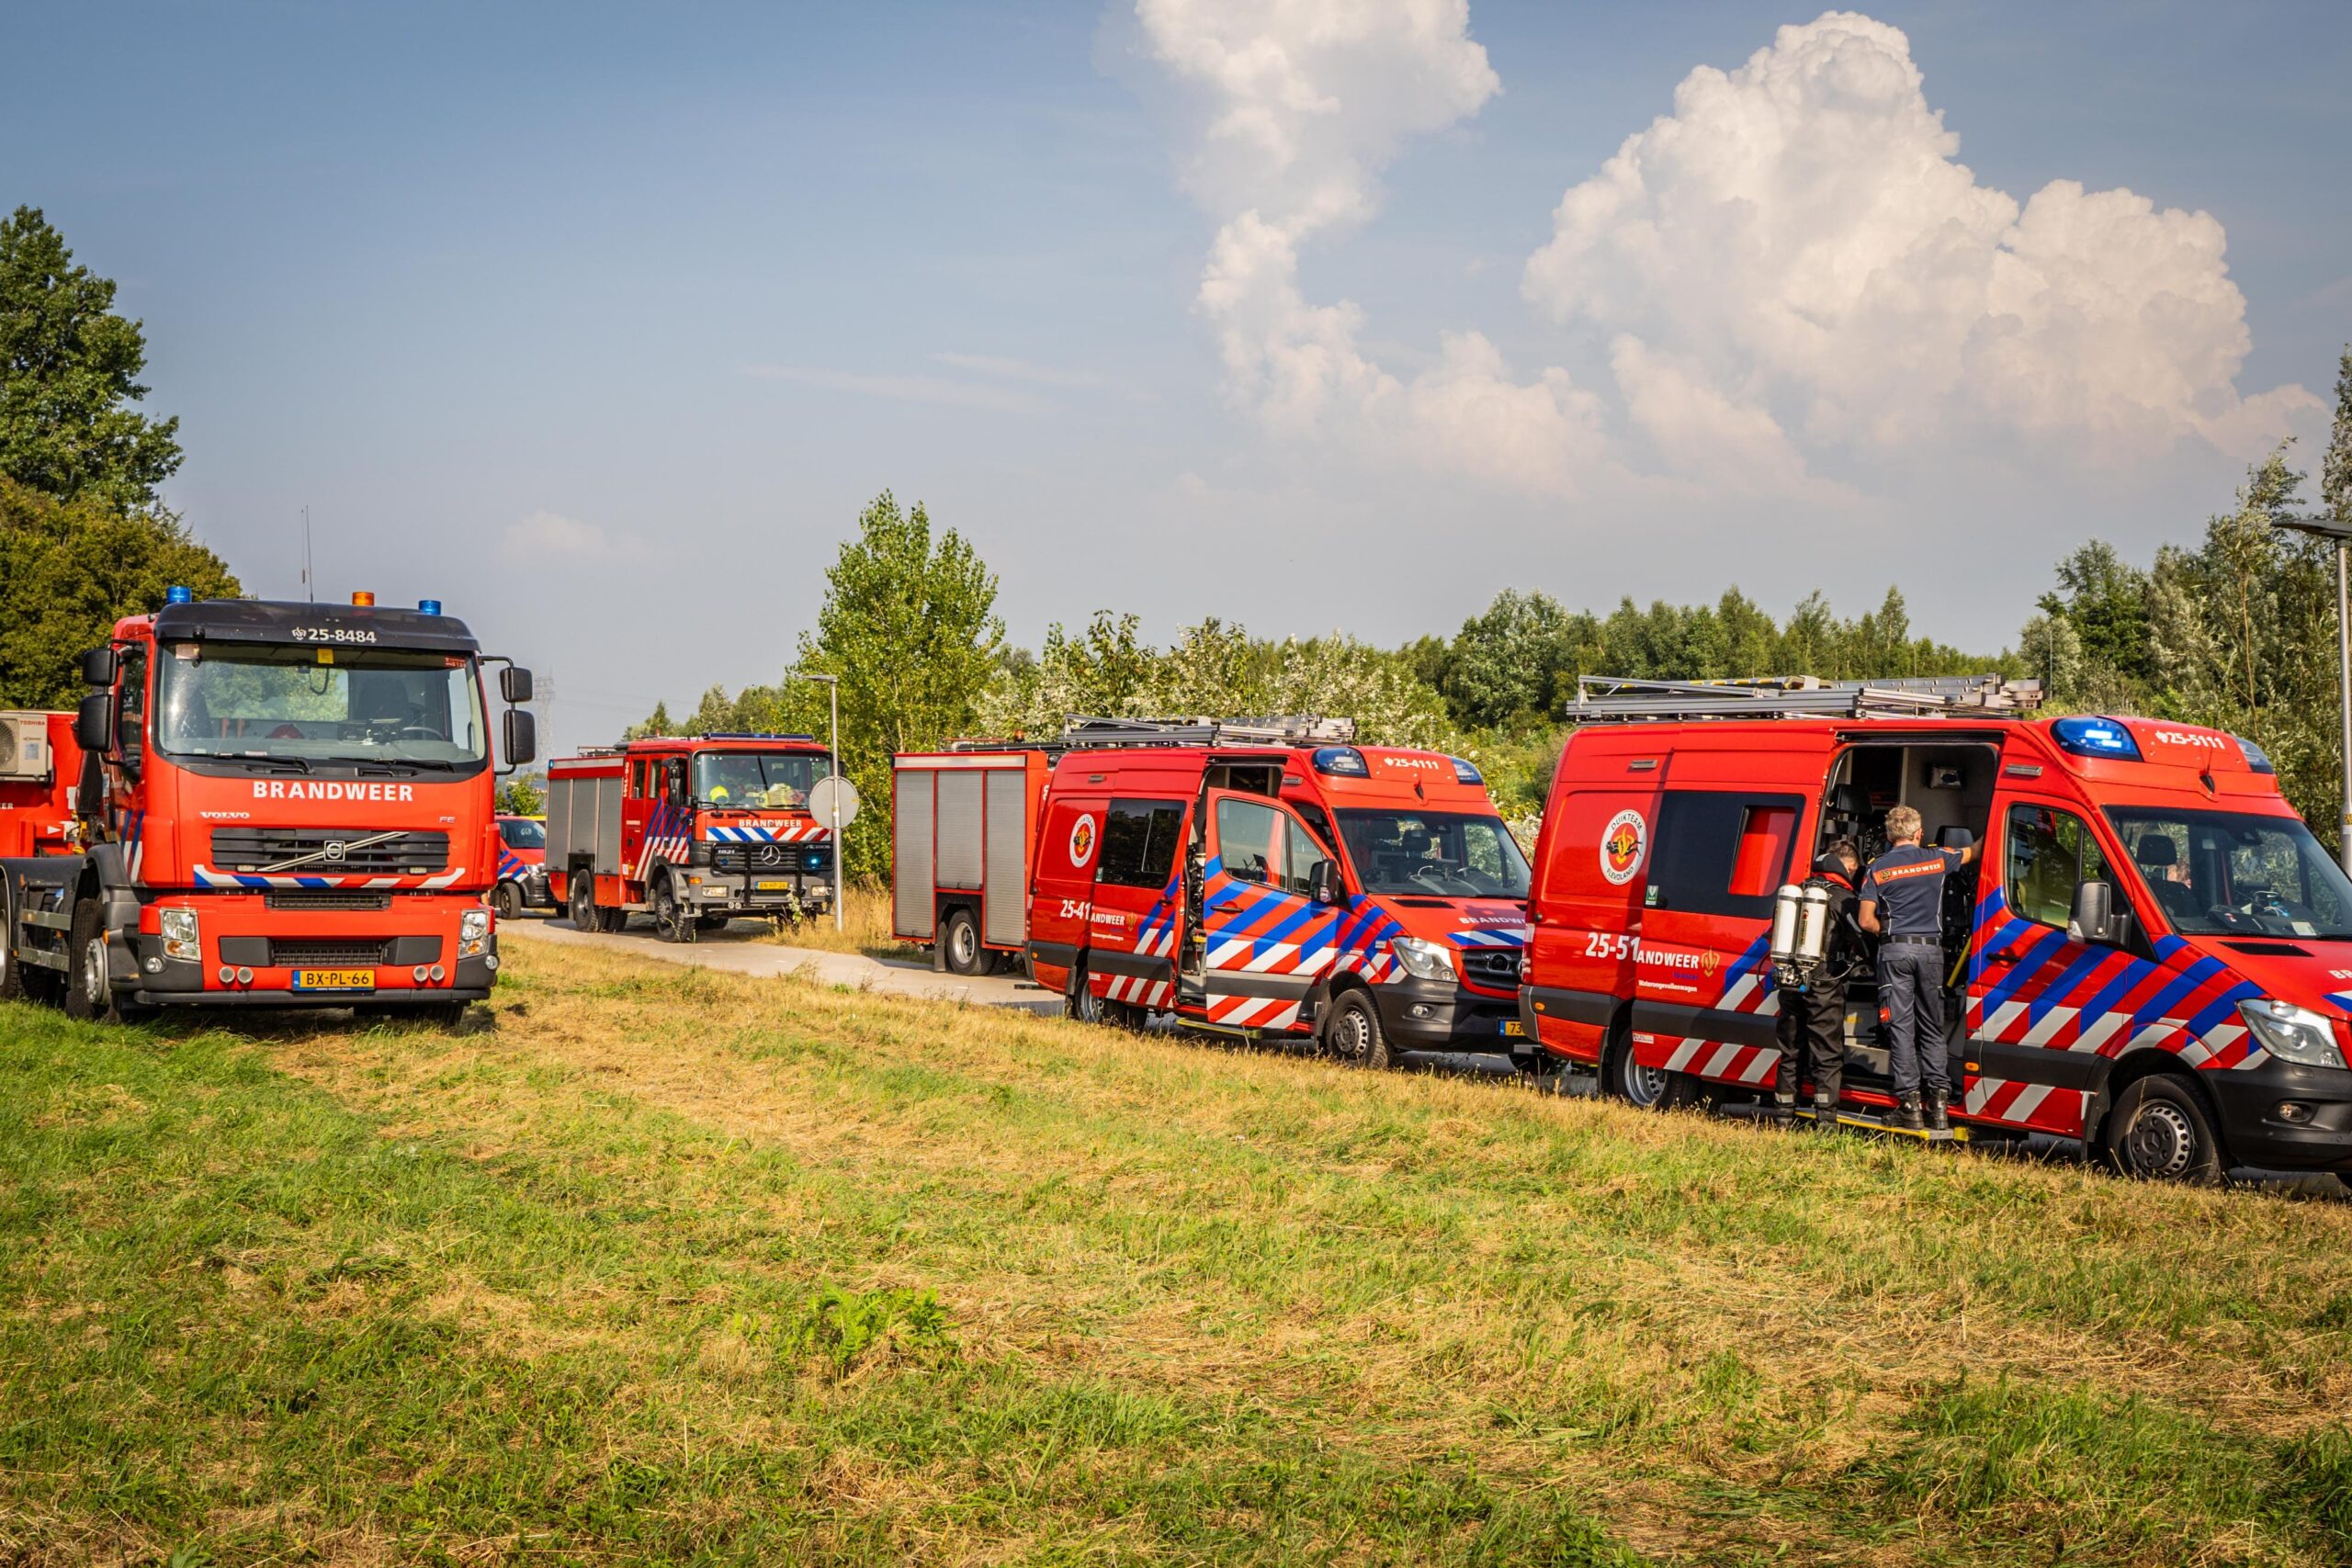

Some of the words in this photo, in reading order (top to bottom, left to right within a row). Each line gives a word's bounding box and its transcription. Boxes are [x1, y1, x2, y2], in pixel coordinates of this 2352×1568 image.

[308, 628, 377, 643] 25-8484
[2165, 731, 2225, 750] 25-5111
[1394, 758, 1439, 770] 25-4111
[253, 781, 413, 801] BRANDWEER
[199, 811, 251, 819] VOLVO
[1611, 813, 1643, 830] DUIKTEAM
[739, 818, 802, 828] BRANDWEER
[1606, 866, 1634, 881] FLEVOLAND
[1090, 912, 1125, 926] ANDWEER
[1636, 950, 1700, 969] ANDWEER
[306, 973, 369, 986] BX-PL-66
